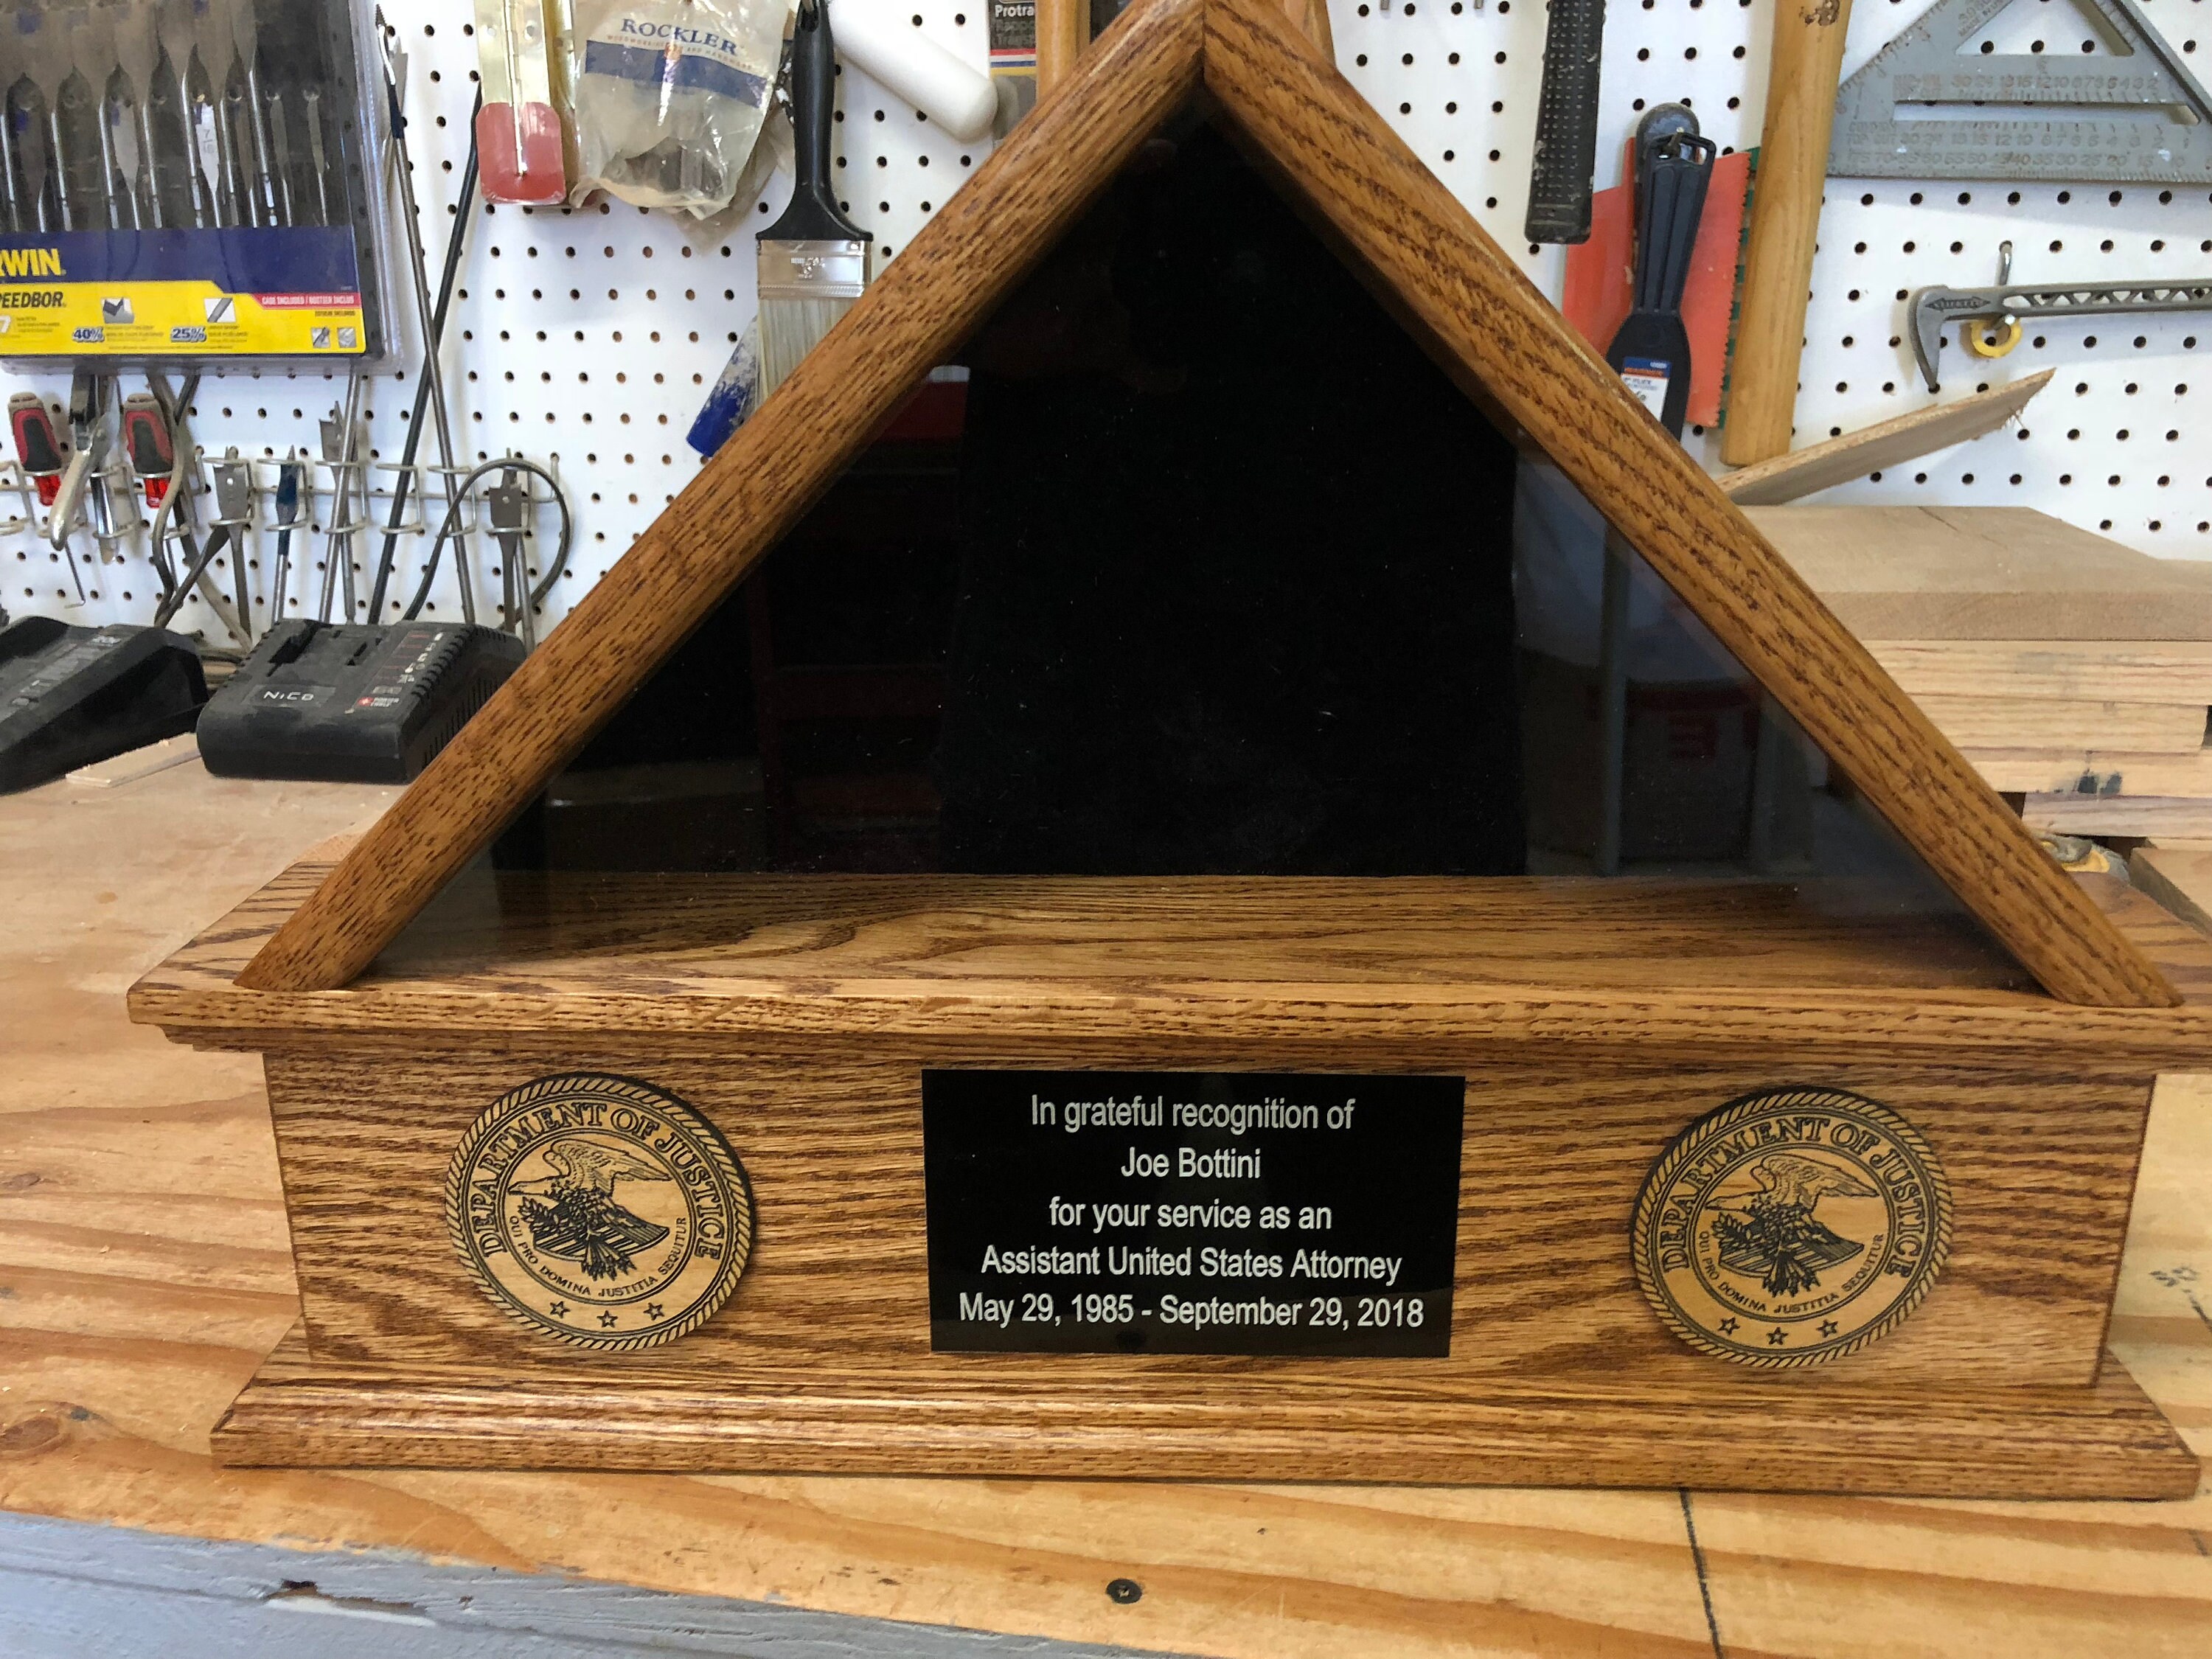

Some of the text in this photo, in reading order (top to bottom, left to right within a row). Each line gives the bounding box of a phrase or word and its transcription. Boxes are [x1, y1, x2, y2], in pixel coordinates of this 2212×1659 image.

[621, 18, 737, 56] ROCKLER
[72, 327, 105, 343] 40%
[170, 327, 206, 343] 25%
[1032, 1094, 1356, 1135] In grateful recognition of
[471, 1102, 726, 1261] DEPARTMENT OF JUSTICE
[1121, 1146, 1261, 1179] Joe Bottini
[1048, 1195, 1332, 1234] for your service as an
[1660, 1116, 1925, 1279] DEPARTMENT OF JUSTICE
[508, 1215, 687, 1298] QUI PRO DOMINA JUSTITIA SEQUITUR
[981, 1244, 1402, 1287] Assistant United States Attorney
[1698, 1230, 1885, 1314] QUI PRO DOMINA JUSTITIA SEQUITUR
[959, 1292, 1015, 1329] May
[1021, 1293, 1061, 1327] 29,
[1071, 1293, 1134, 1324] 1985
[1159, 1294, 1304, 1331] September
[1309, 1297, 1349, 1331] 29,
[1357, 1297, 1424, 1328] 2018
